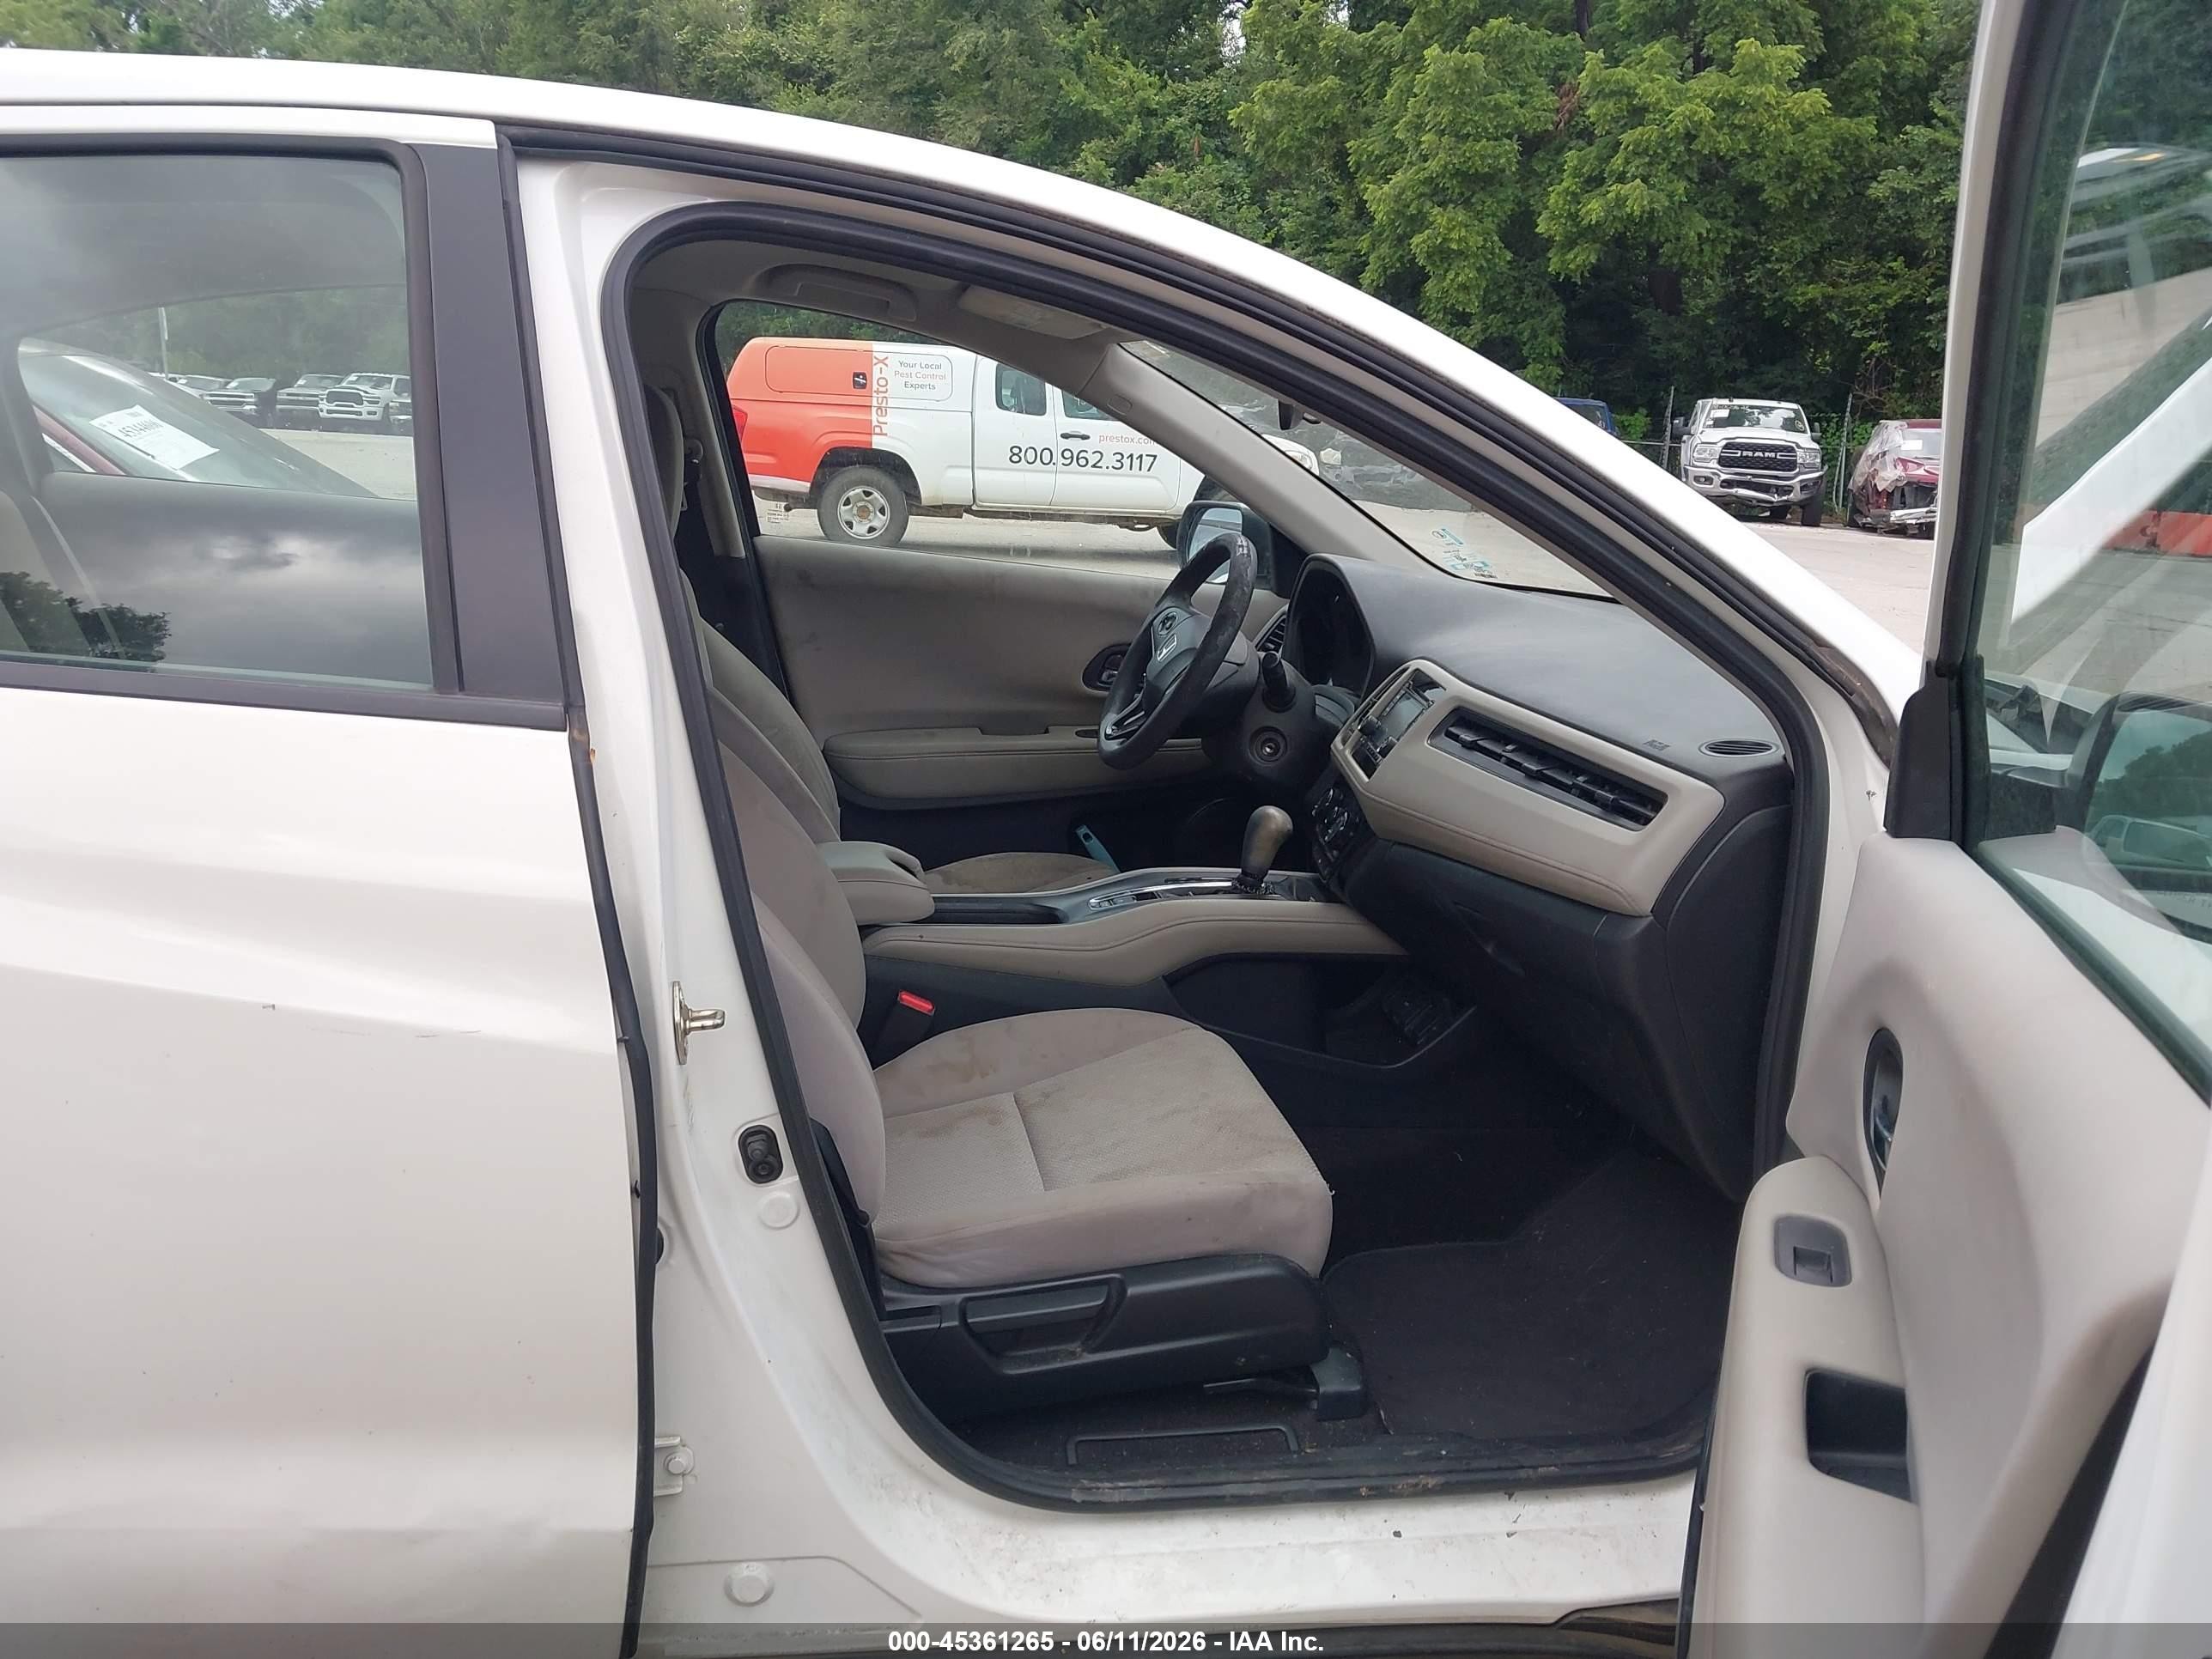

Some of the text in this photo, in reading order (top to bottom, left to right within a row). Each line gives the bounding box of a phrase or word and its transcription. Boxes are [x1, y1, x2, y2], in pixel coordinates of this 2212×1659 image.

[898, 361, 942, 370] Your Local
[915, 371, 946, 380] Control
[904, 380, 936, 391] Experts
[873, 356, 889, 436] Presto-X
[1008, 445, 1158, 472] 800.962.3117
[1741, 450, 1776, 459] RAM
